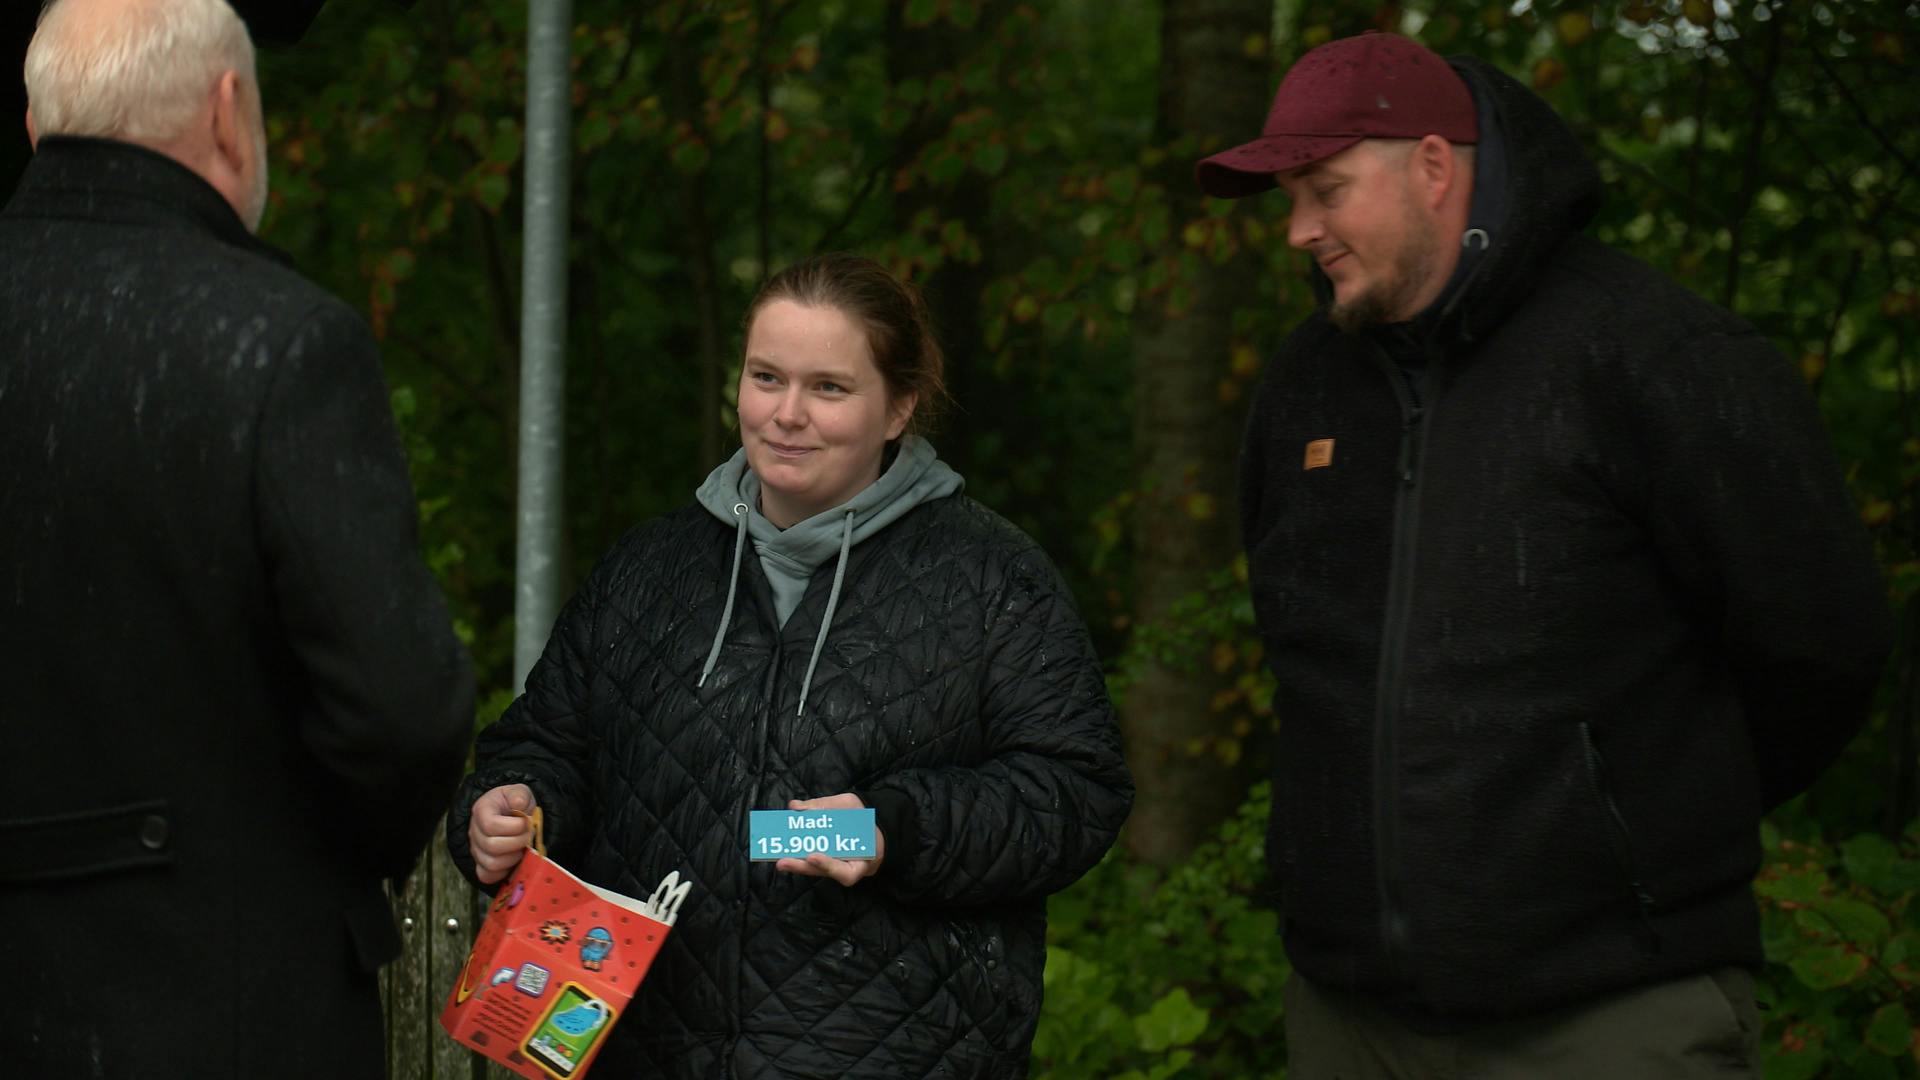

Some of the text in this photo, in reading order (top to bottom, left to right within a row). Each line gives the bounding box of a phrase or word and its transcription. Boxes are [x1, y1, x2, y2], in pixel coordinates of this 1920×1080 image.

[788, 814, 833, 829] Mad:
[757, 834, 866, 854] 15.900 kr.
